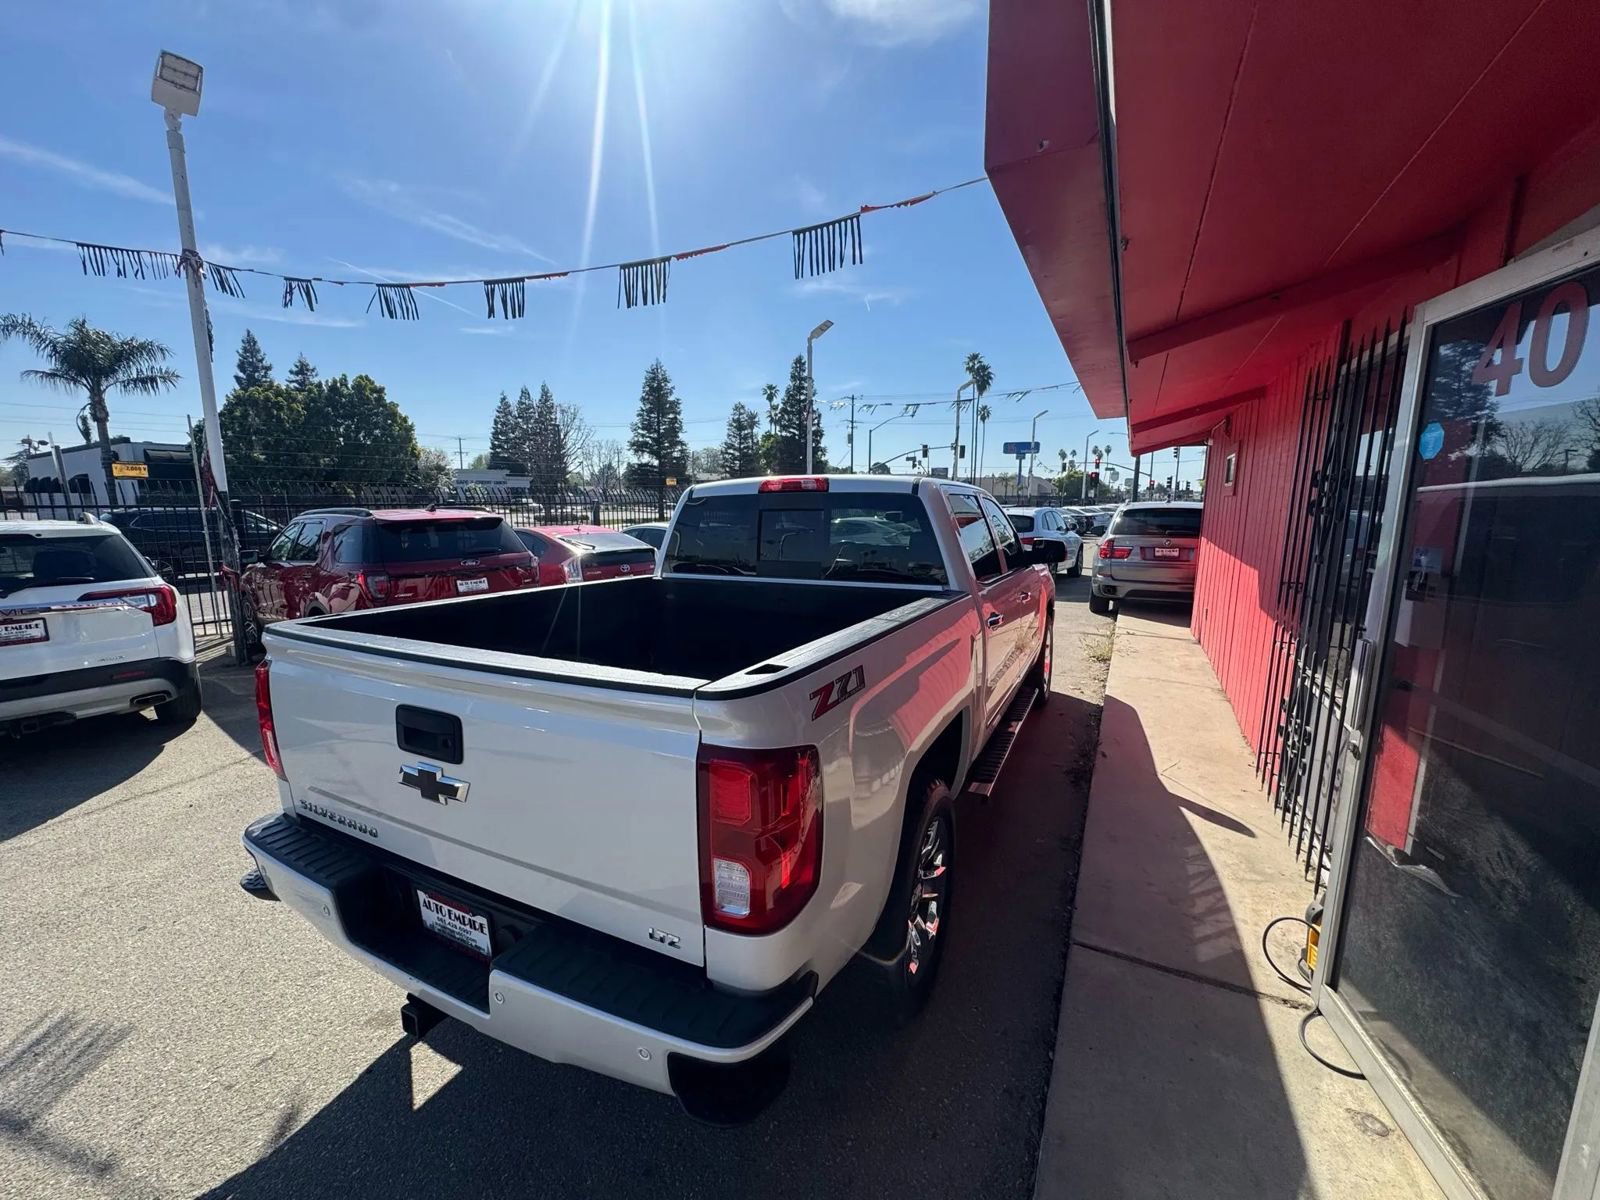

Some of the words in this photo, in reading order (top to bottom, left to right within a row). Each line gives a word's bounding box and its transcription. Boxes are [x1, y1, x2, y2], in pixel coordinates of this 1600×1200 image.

[1471, 281, 1590, 397] 40
[4, 623, 41, 632] EMPIRE
[809, 664, 866, 721] Z71
[300, 799, 379, 838] SILVERADO
[422, 898, 447, 917] AUTO
[447, 908, 487, 936] EMPIRE
[648, 927, 681, 949] LTZ
